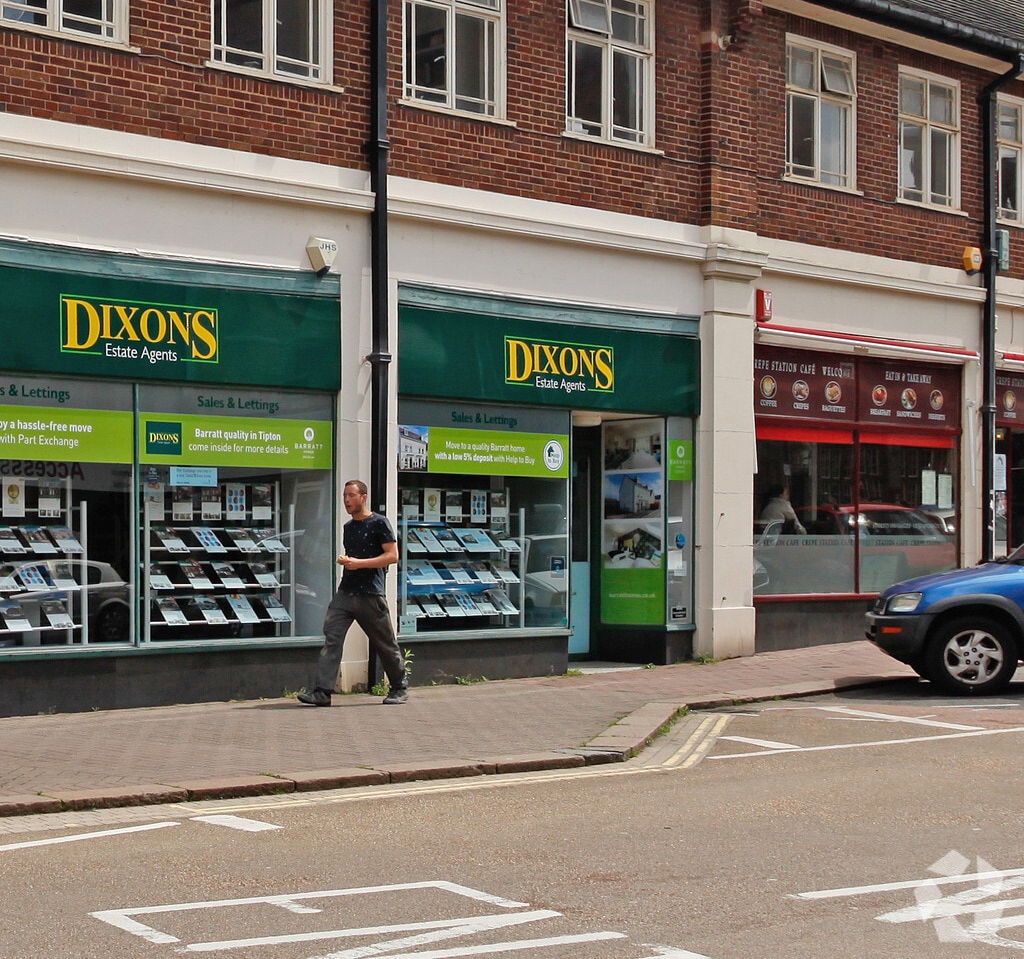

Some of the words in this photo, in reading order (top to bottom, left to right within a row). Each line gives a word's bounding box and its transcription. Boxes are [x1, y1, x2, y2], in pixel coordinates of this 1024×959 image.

[320, 243, 336, 251] JHS
[62, 298, 216, 360] DIXONS
[105, 343, 138, 359] Estate
[141, 346, 178, 364] Agents
[506, 339, 613, 389] DIXONS
[771, 361, 797, 373] STATION
[885, 371, 895, 381] EAT
[895, 372, 901, 381] IN
[907, 373, 919, 383] TAKE
[536, 376, 558, 389] Estate
[560, 378, 586, 393] Agents
[8, 384, 18, 397] &
[22, 385, 70, 403] Lettings
[197, 395, 224, 409] Sales
[227, 397, 235, 409] &
[238, 398, 280, 414] Lettings
[10, 421, 15, 429] a
[17, 419, 68, 432] hassle-free
[69, 423, 93, 433] move
[451, 411, 473, 422] Sales
[476, 413, 482, 422] &
[484, 413, 518, 428] Lettings
[18, 434, 37, 445] Part
[39, 435, 79, 449] Exchange
[149, 432, 179, 444] DIXONS
[195, 428, 223, 439] Barratt
[224, 430, 249, 442] quality
[250, 431, 258, 440] in
[258, 431, 281, 442] Tipton
[188, 444, 209, 452] come
[210, 443, 232, 452] inside
[233, 443, 244, 453] for
[245, 445, 264, 453] more
[266, 444, 289, 454] details
[294, 442, 323, 450] BARRATT
[445, 441, 460, 450] Move
[461, 441, 467, 450] to
[472, 443, 490, 453] quality
[490, 443, 509, 452] Barratt
[510, 444, 526, 453] home
[434, 452, 447, 460] with
[452, 452, 463, 461] low
[463, 452, 472, 461] 5%
[473, 453, 493, 463] deposit
[494, 455, 505, 463] with
[505, 455, 517, 464] Help
[518, 456, 524, 464] to
[524, 456, 535, 465] Buy
